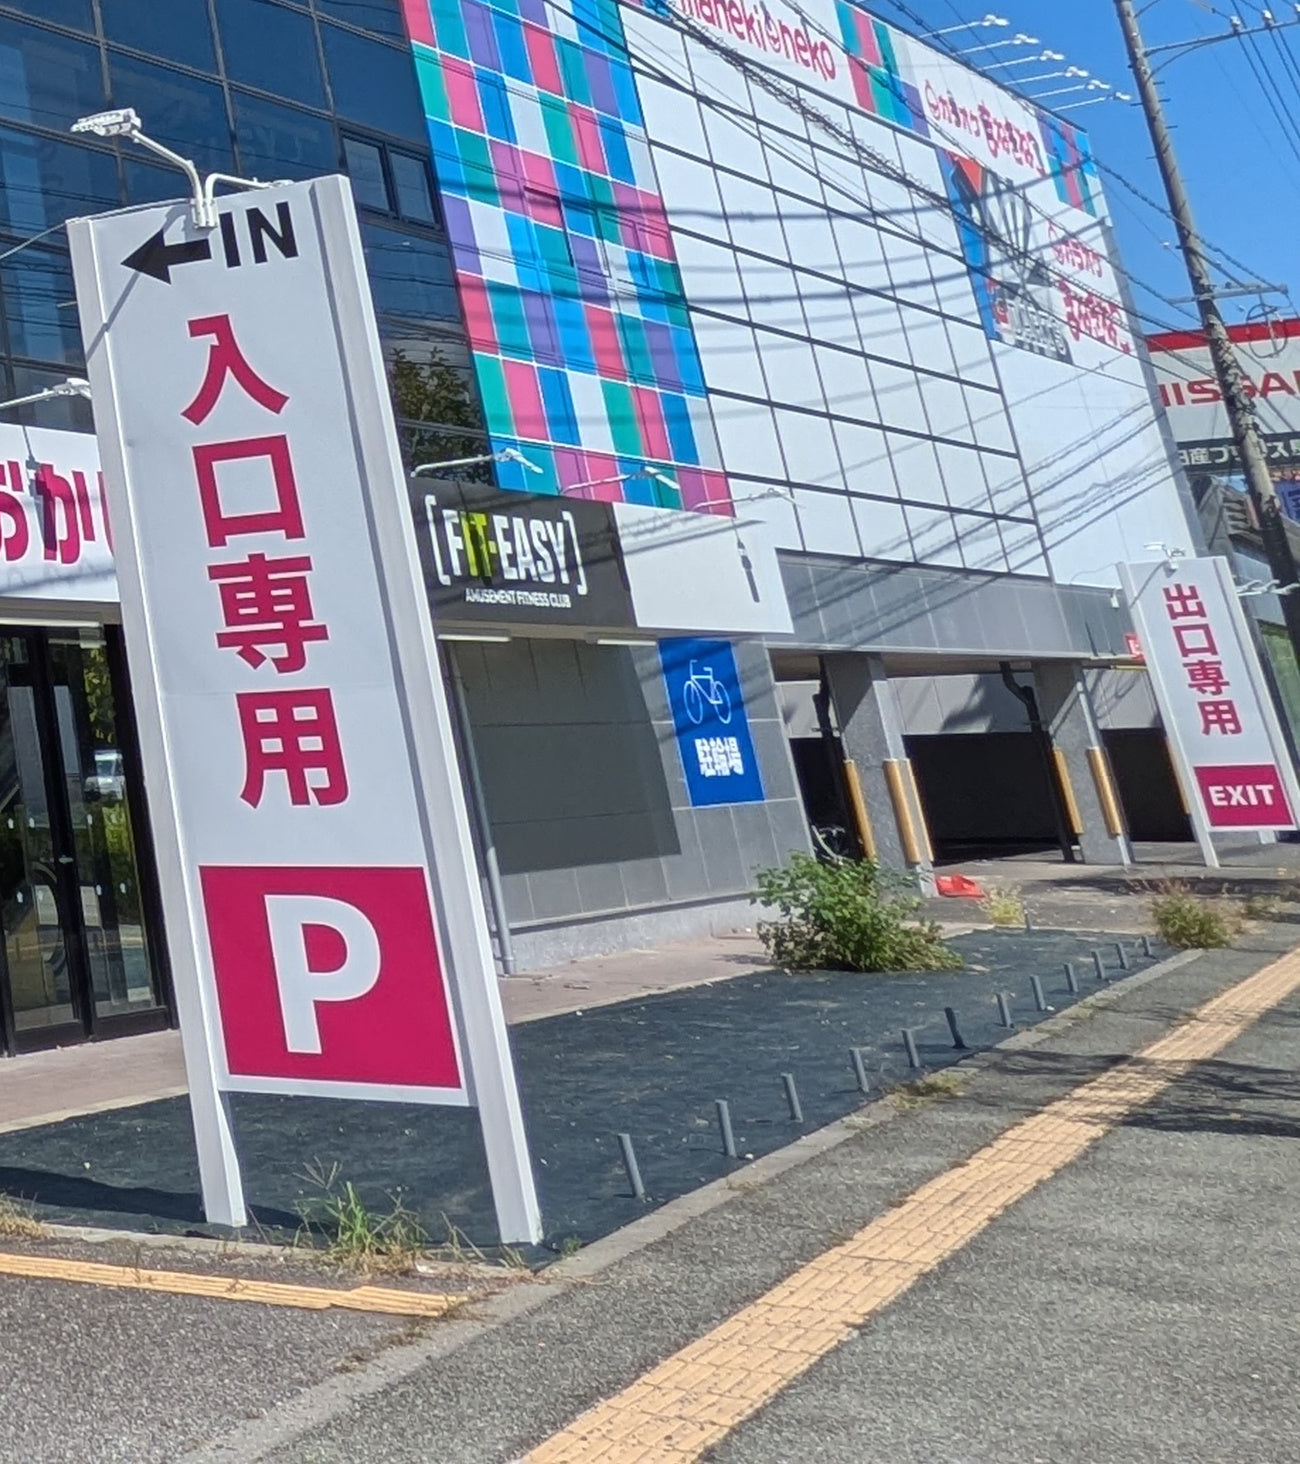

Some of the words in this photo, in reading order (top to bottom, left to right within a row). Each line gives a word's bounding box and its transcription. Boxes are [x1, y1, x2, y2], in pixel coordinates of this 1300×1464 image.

[219, 201, 299, 268] IN
[181, 313, 351, 810] 入口専用
[465, 588, 516, 605] AMUSEMENT
[517, 588, 550, 607] FITNESS
[550, 592, 572, 608] CLUB
[1162, 583, 1243, 736] 出口専用
[1209, 784, 1274, 807] EXIT
[264, 893, 381, 1054] P
